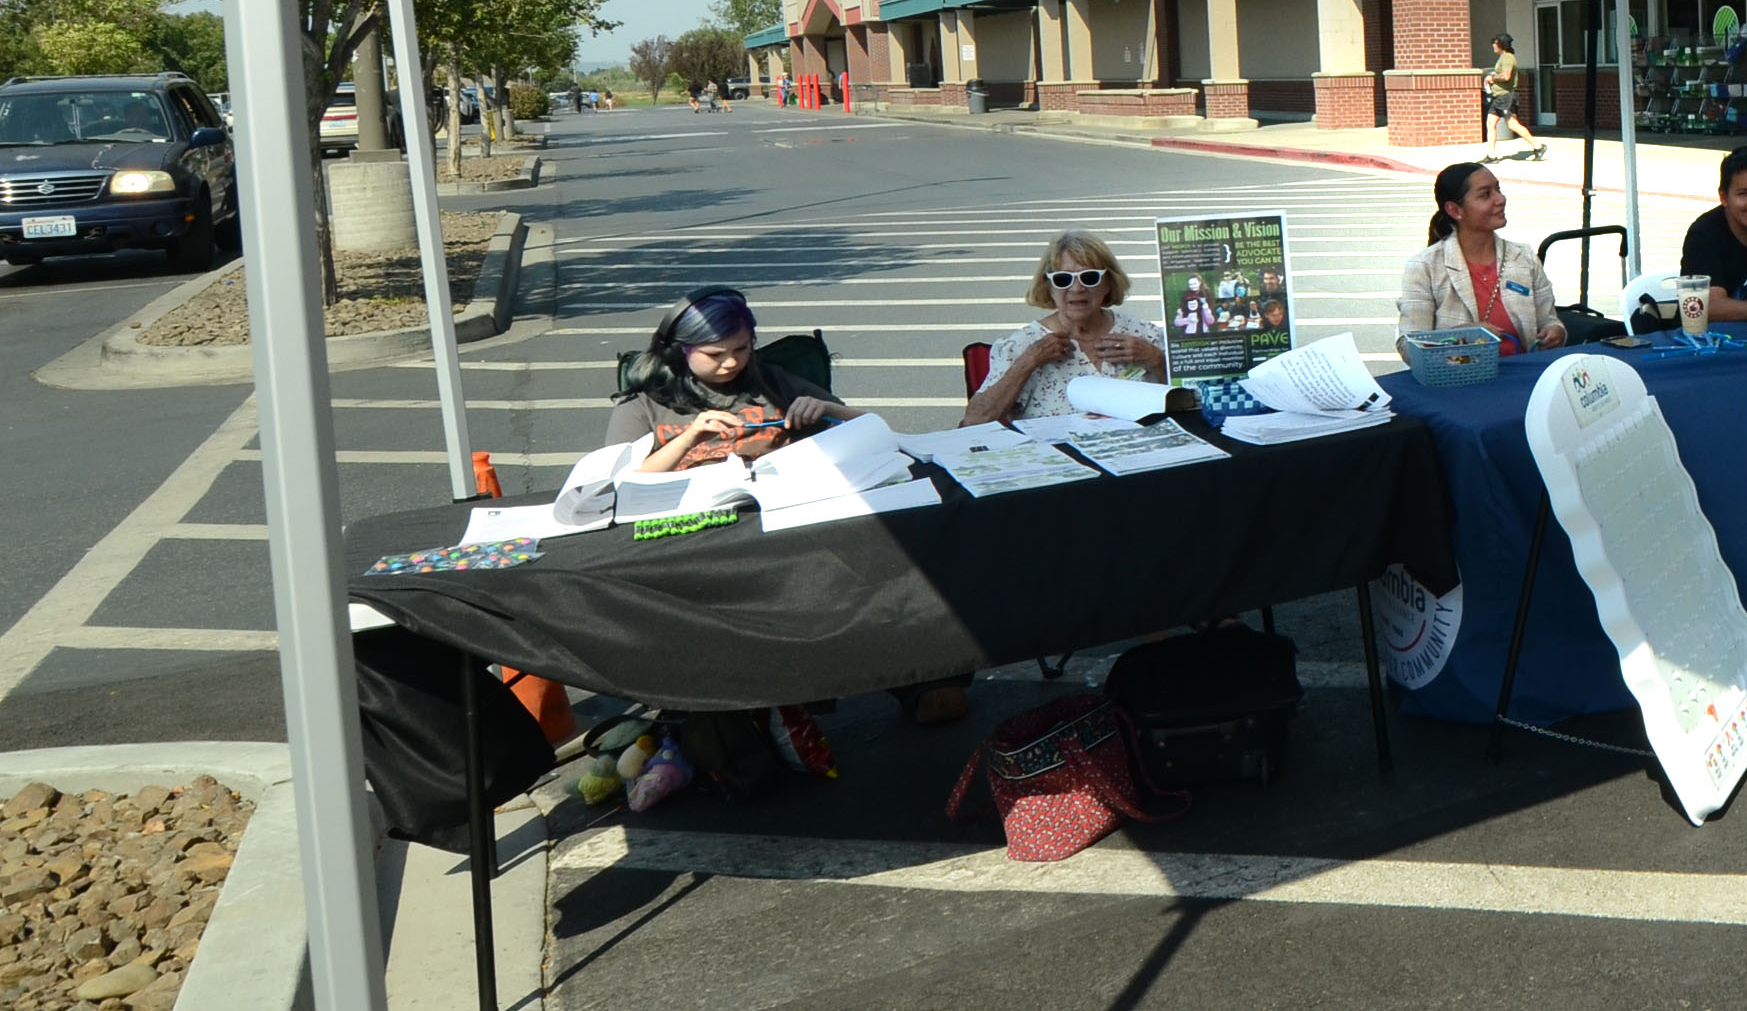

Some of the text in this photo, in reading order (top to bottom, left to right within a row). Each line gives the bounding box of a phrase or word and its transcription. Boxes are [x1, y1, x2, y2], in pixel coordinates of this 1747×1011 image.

[1160, 220, 1280, 243] Our Mission & Vision
[1246, 240, 1262, 248] THE
[1262, 239, 1280, 247] BEST
[1236, 247, 1281, 257] ADVOCATE
[1251, 330, 1289, 346] PAVE
[1400, 602, 1454, 681] COMMUNITY
